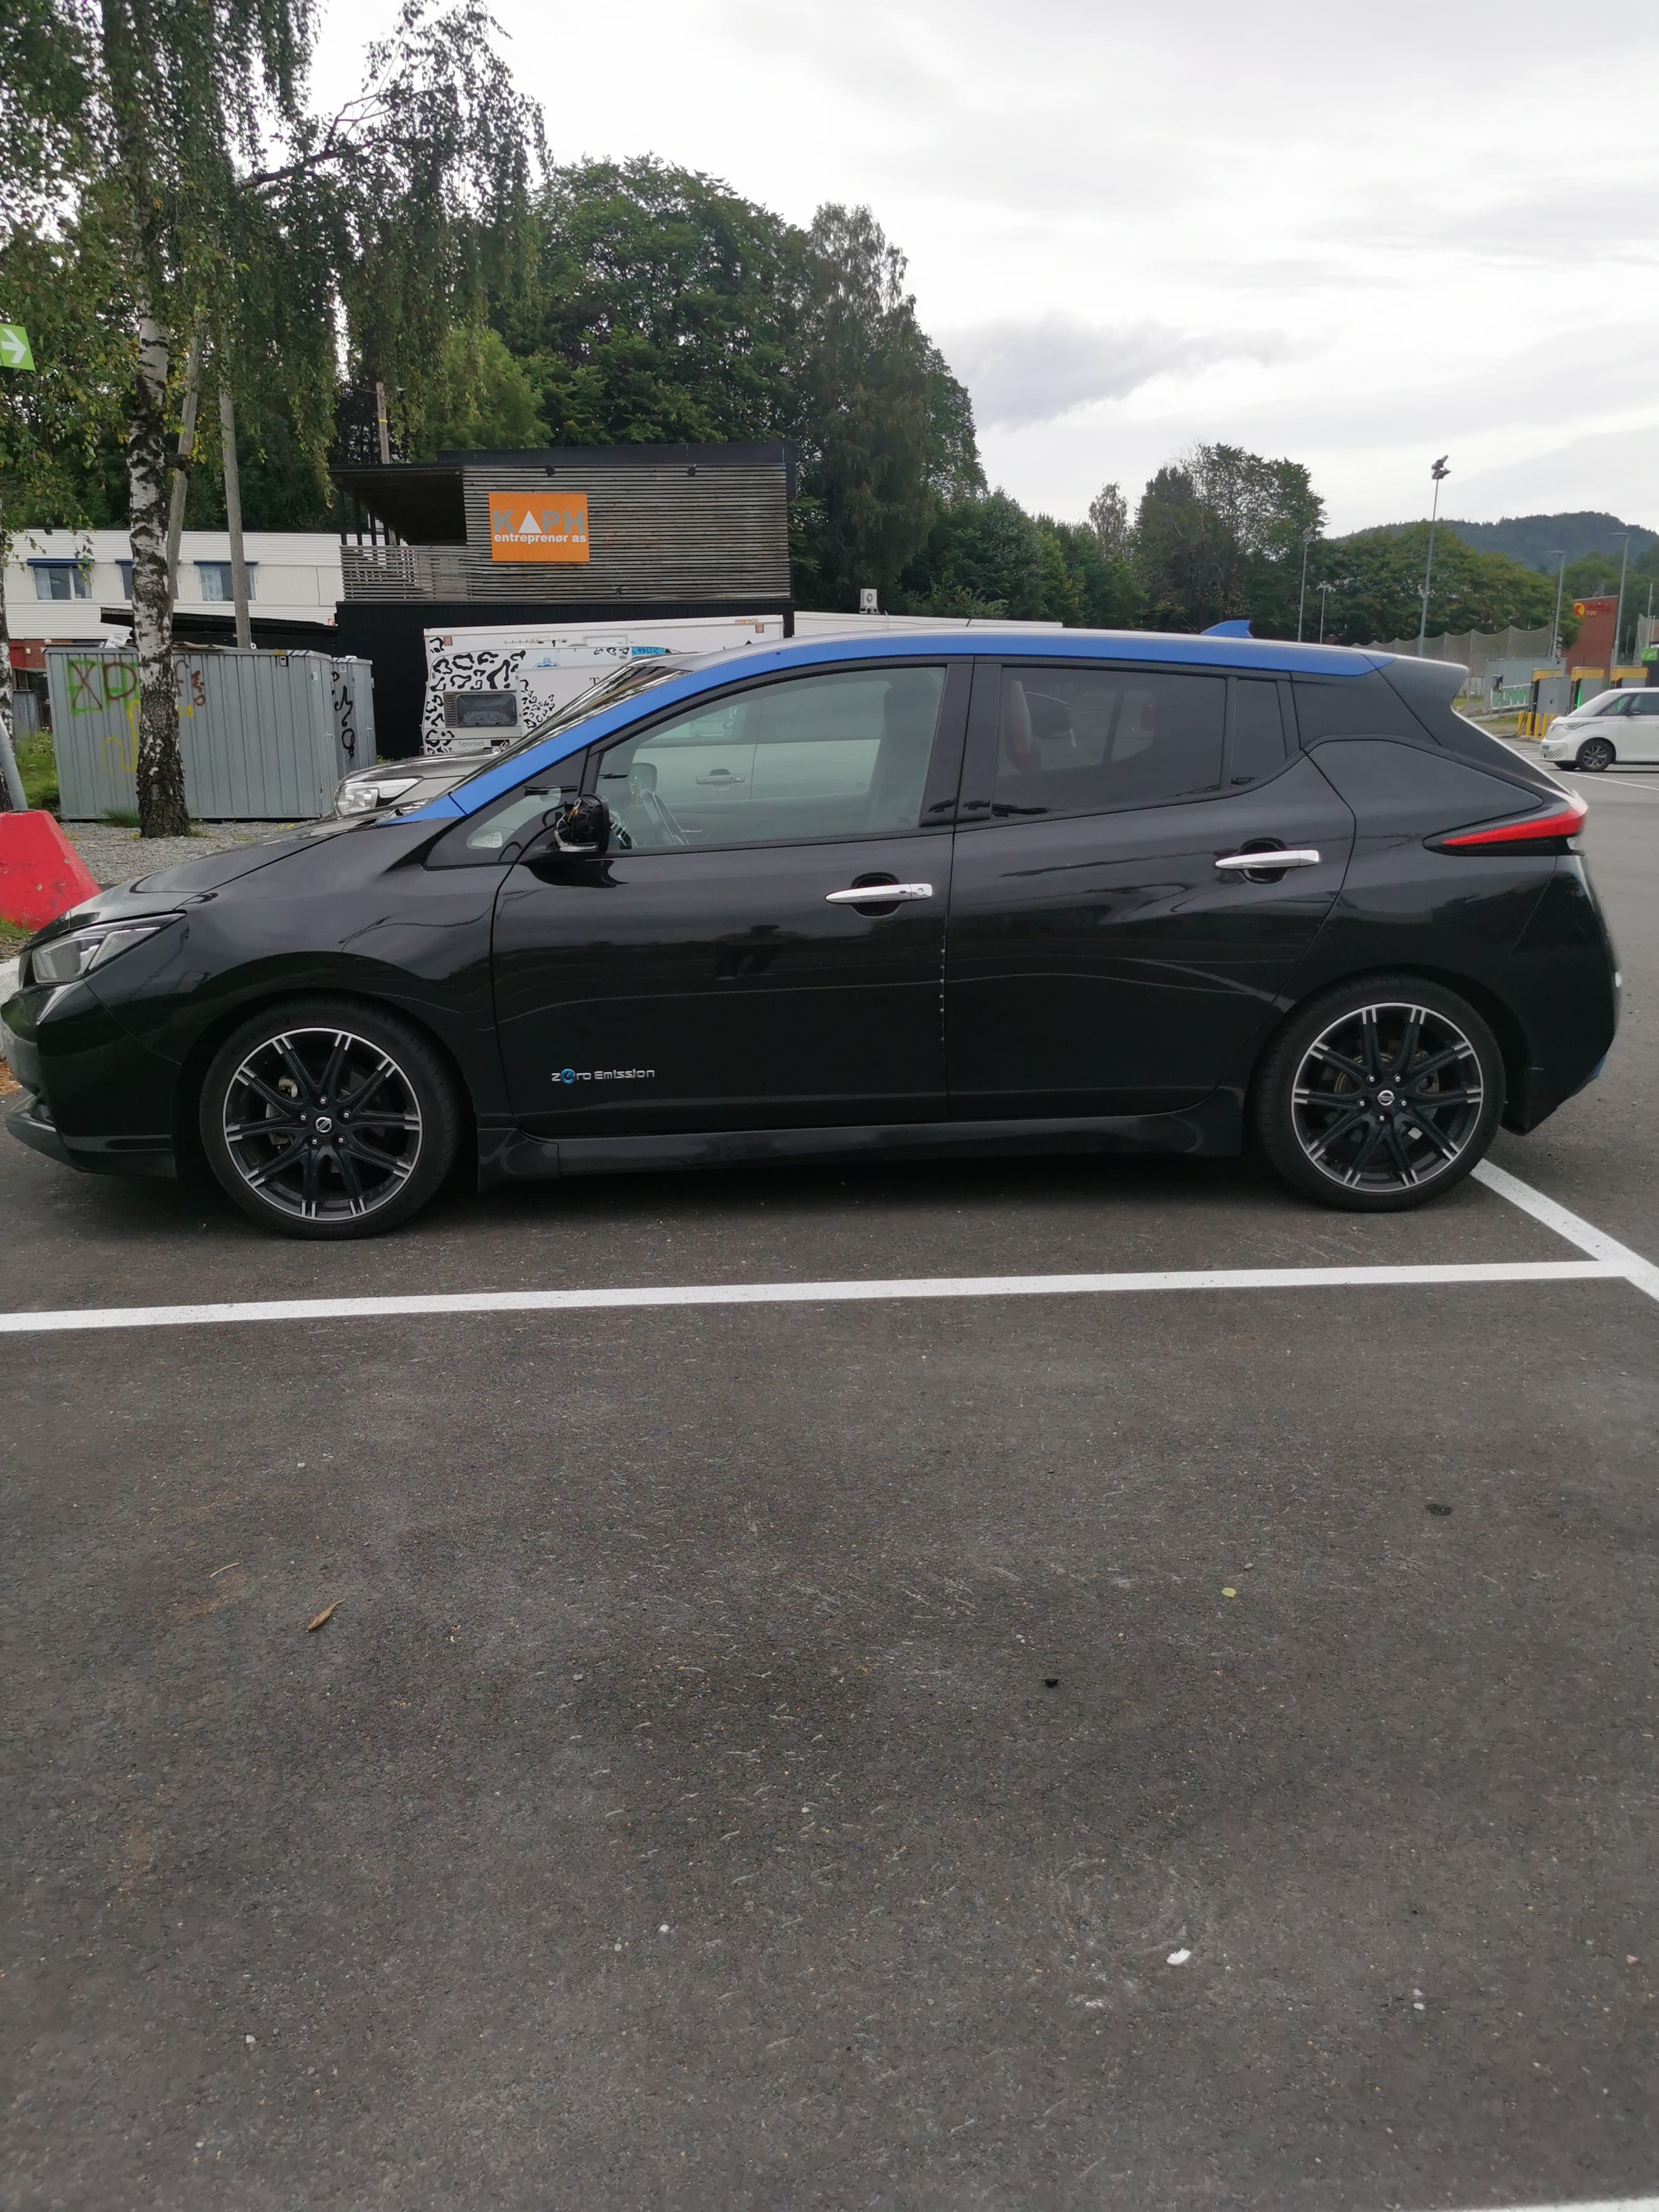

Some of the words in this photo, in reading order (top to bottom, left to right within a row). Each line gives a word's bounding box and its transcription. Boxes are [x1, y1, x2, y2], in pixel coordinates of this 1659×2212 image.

[494, 533, 568, 544] entreprenør
[572, 534, 586, 543] as
[595, 1068, 655, 1080] Emission
